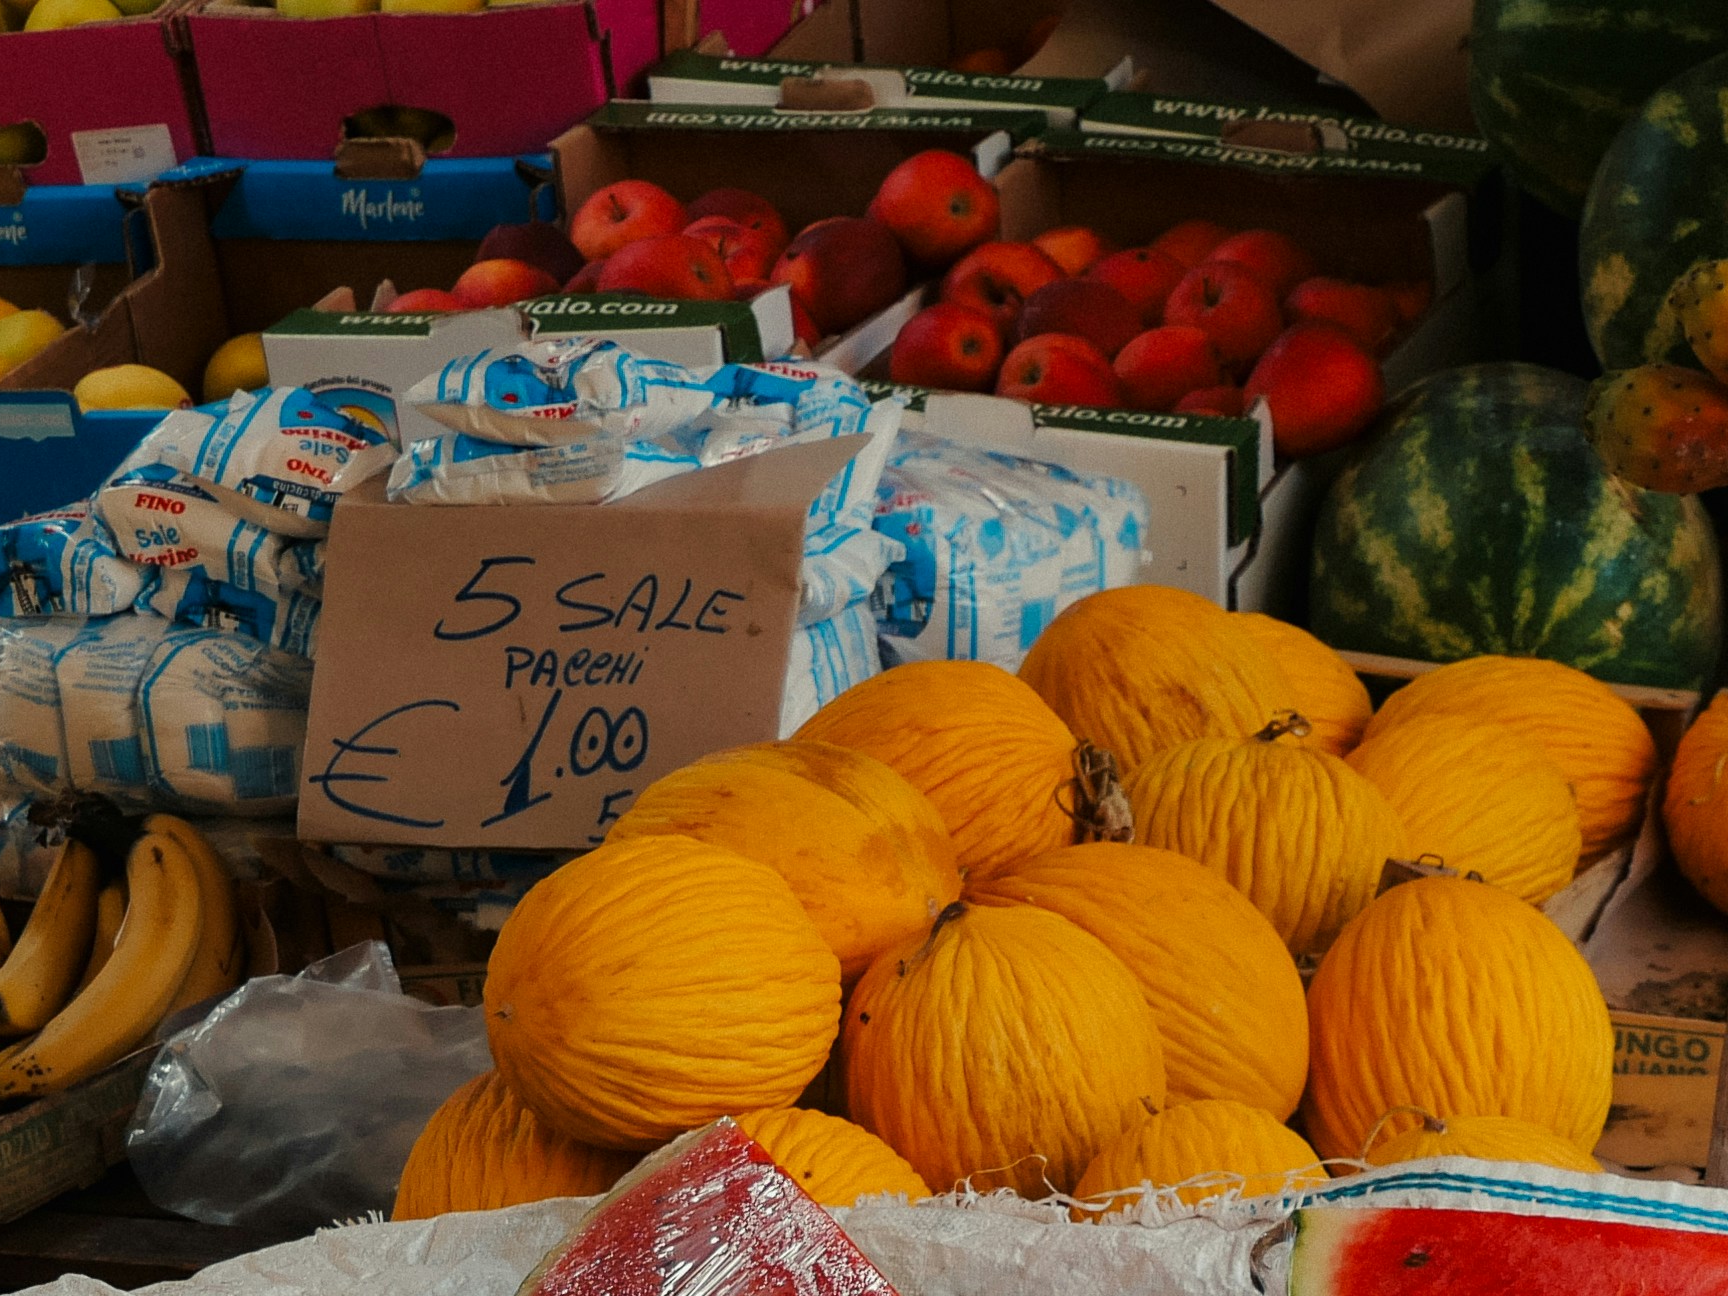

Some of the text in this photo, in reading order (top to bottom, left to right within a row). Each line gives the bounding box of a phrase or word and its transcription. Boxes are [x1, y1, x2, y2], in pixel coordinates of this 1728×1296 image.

[340, 189, 425, 230] Marlene
[298, 438, 350, 464] Sale
[134, 493, 186, 515] FINO
[135, 522, 181, 549] Sale
[434, 555, 747, 642] 5 SALE
[308, 699, 462, 829] €
